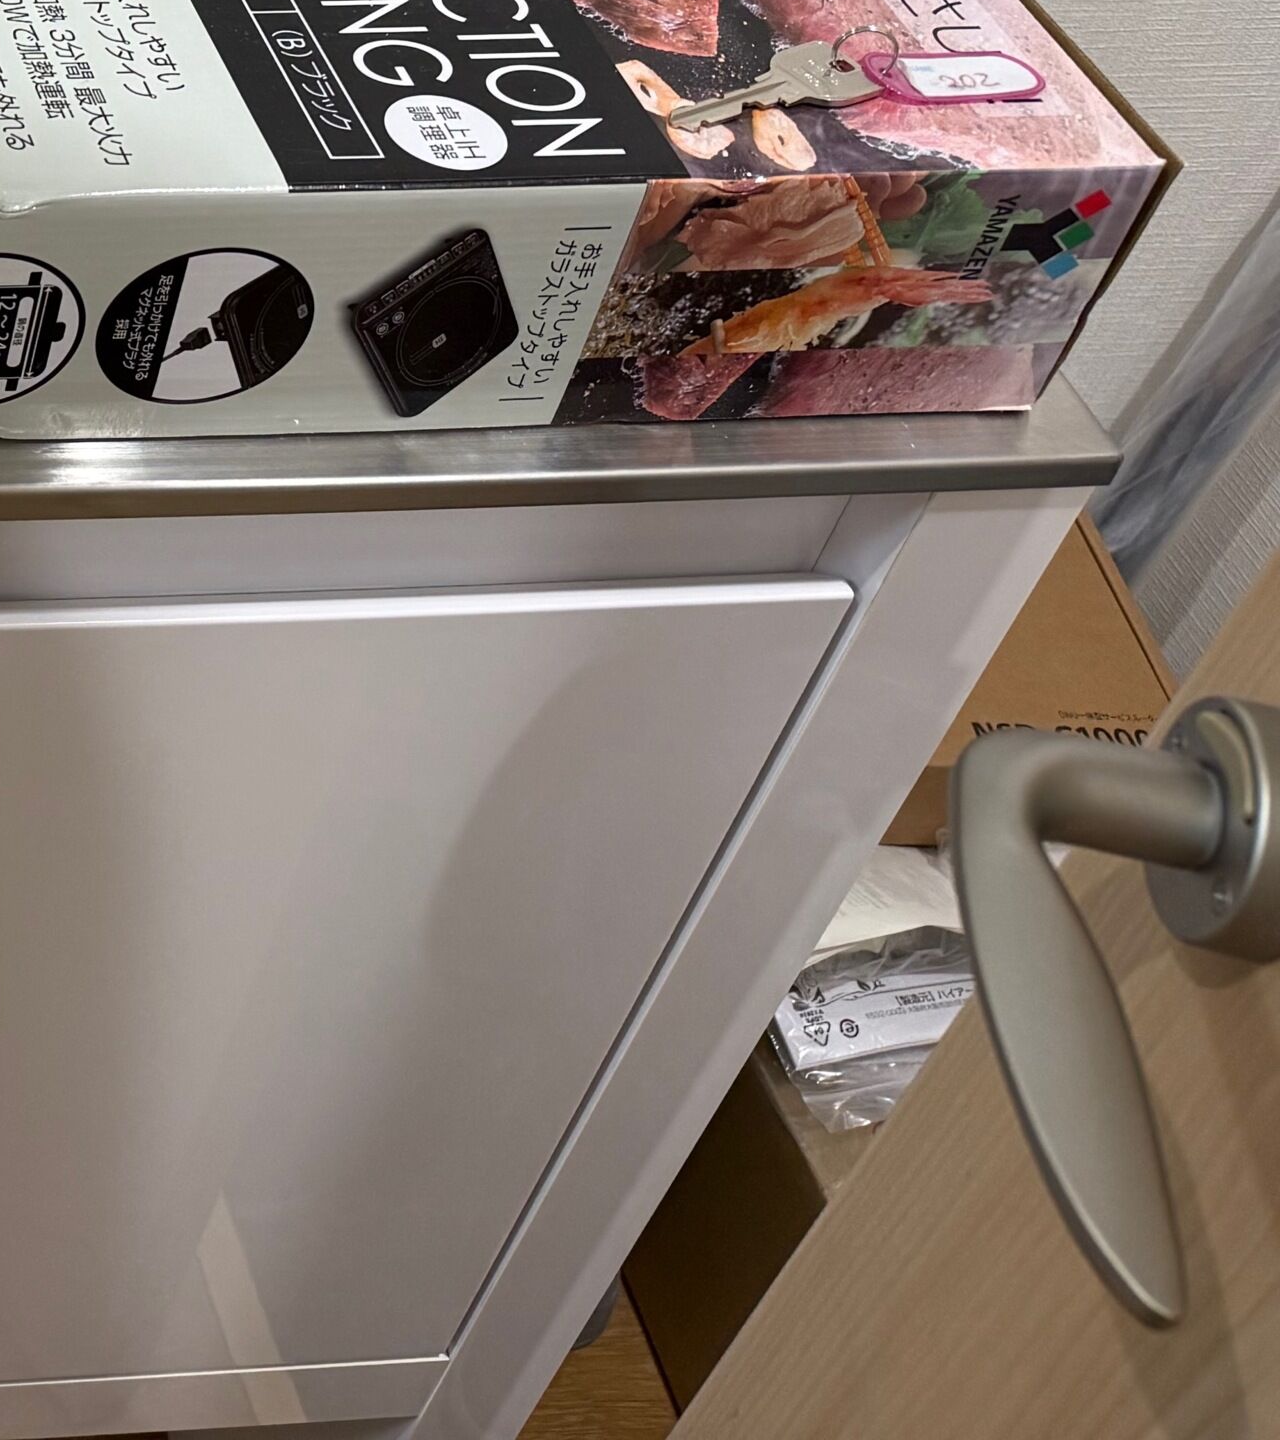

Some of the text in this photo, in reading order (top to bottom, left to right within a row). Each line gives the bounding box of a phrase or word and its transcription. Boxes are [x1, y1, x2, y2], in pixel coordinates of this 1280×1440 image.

[45, 28, 95, 80] 3分間
[70, 86, 136, 167] 最大火力
[403, 105, 460, 160] 調理器
[430, 104, 487, 159] 卓上IH
[957, 194, 1021, 281] YAMAZEN
[111, 318, 129, 340] 採用
[120, 286, 153, 370] マグネット式プラグ
[133, 274, 174, 381] 足を引っかけても外れる
[502, 239, 579, 389] ガラストップタイプ
[530, 243, 604, 384] お手入れしやすい
